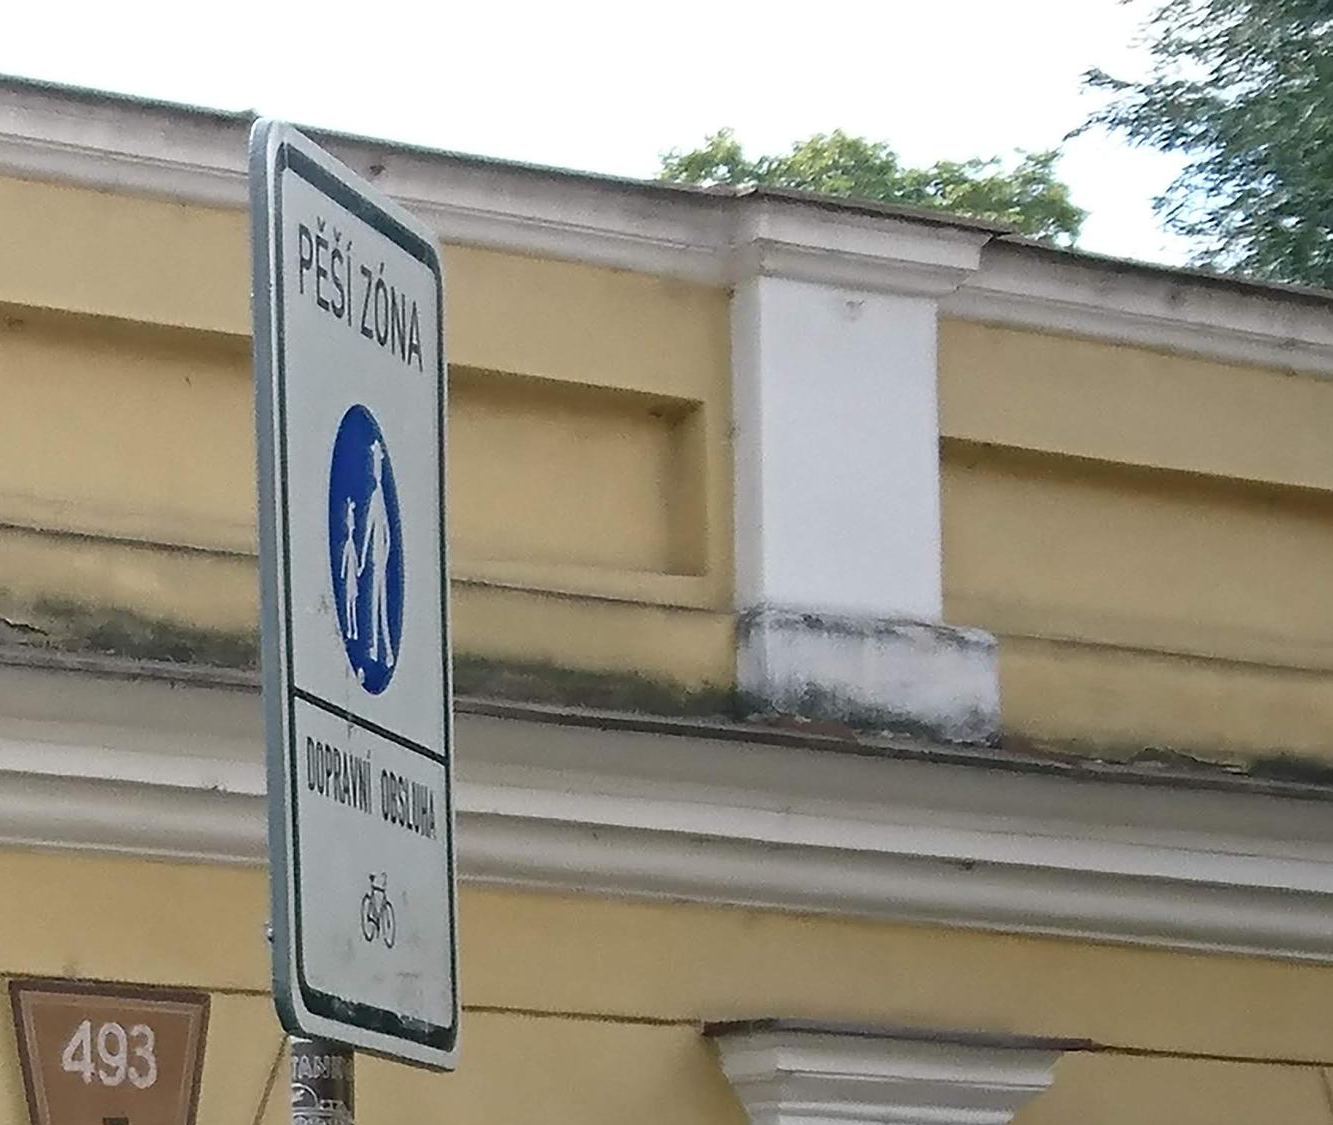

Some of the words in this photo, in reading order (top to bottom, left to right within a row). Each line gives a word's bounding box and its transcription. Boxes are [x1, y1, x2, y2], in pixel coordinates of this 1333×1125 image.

[298, 216, 353, 327] PĚŠÍ
[360, 262, 423, 372] ZÓNA
[61, 1019, 158, 1089] 493
